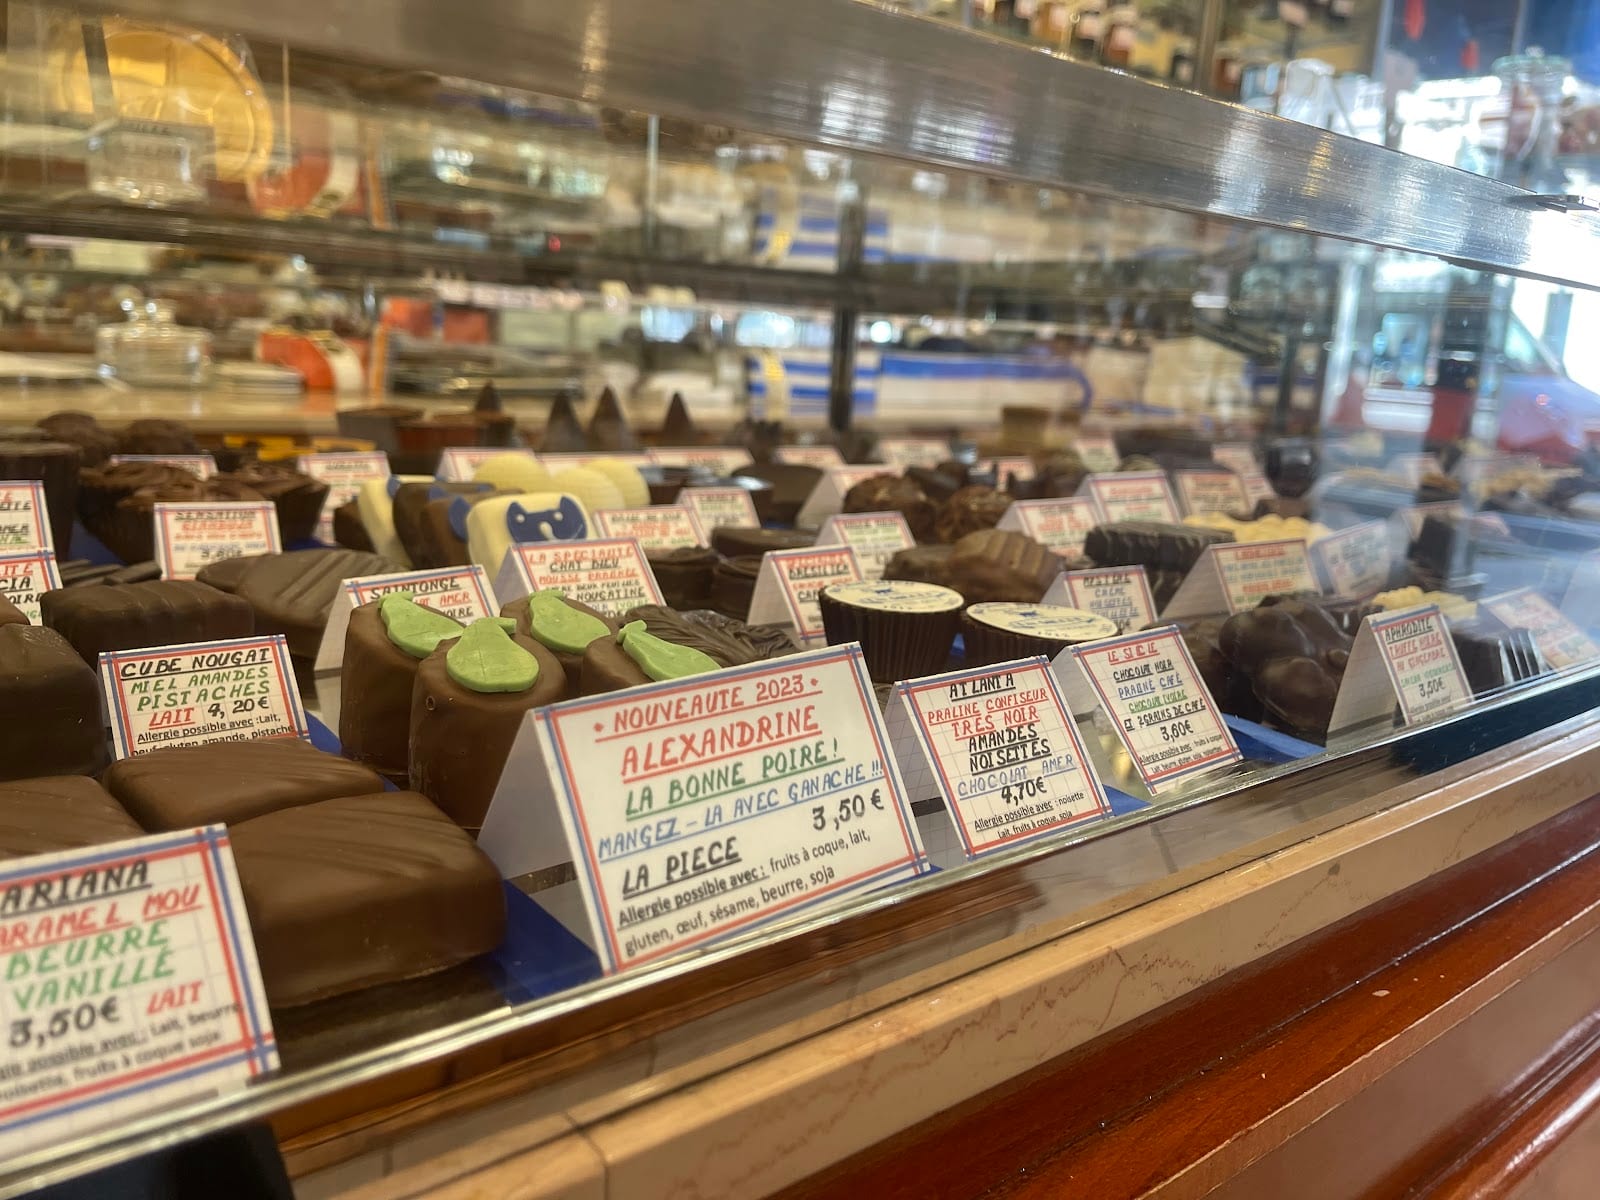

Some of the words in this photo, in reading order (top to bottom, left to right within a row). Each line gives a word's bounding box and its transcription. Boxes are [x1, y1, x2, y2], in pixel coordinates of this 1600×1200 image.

[530, 552, 546, 564] LA
[550, 560, 582, 571] CHAT
[539, 573, 581, 584] MOUSSE
[577, 586, 646, 600] NOUGATINE
[444, 607, 474, 617] OIRE
[1386, 617, 1433, 641] APHRODITE
[121, 658, 182, 677] CUBE
[192, 648, 270, 669] NOUGAT
[1108, 651, 1119, 663] LE
[1113, 663, 1151, 680] CHOCOLAT
[1154, 659, 1174, 672] NOIR
[131, 678, 177, 694] MIEL
[188, 666, 269, 687] AMANDES
[950, 673, 1014, 698] ATLANTA
[1419, 677, 1445, 698] 3,50€
[137, 681, 270, 711] PISTACHES
[614, 686, 744, 733] NOUVEAUTE
[756, 674, 804, 702] 2023
[928, 702, 980, 724] PRALINE
[986, 688, 1048, 711] CONFISEUR
[1128, 695, 1162, 713] CHOCOLAT
[138, 729, 180, 742] Allergie
[183, 722, 226, 737] possible
[229, 717, 254, 729] avec
[149, 707, 195, 726] LAIT
[952, 715, 996, 738] TRES
[1004, 705, 1039, 726] NOIR
[1124, 719, 1133, 730] ET
[1172, 705, 1184, 717] DE
[1160, 720, 1193, 743] 3,60€
[621, 705, 819, 776] ALEXANDRINE
[969, 723, 1038, 753] AMANDES
[970, 739, 1051, 772] NOISETTES
[626, 785, 653, 816] LA
[668, 761, 746, 804] BONNE
[957, 766, 1028, 797] CHOCOLAT
[1042, 754, 1074, 775] AMER
[1001, 776, 1047, 806] 4,70€
[598, 816, 681, 859] MANGEZ
[705, 804, 722, 826] LA
[734, 788, 780, 818] AVEC
[974, 815, 1004, 831] Allergie
[1005, 805, 1035, 824] possible
[1035, 800, 1053, 812] avec
[1012, 822, 1031, 837] fruits
[619, 896, 671, 926] Allergie
[674, 878, 727, 910] possible
[770, 853, 801, 872] fruits
[802, 847, 810, 862] à
[812, 838, 849, 858] coque,
[849, 829, 871, 846] lait,
[622, 863, 649, 895] LA
[666, 836, 740, 881] PIECE
[0, 859, 148, 913] ARIANA
[142, 884, 200, 917] MOU
[625, 927, 674, 957] gluten,
[709, 895, 760, 923] sésame,
[760, 878, 808, 903] beurre,
[810, 865, 835, 885] soja
[6, 919, 168, 981] BEURRE
[13, 948, 175, 1012] VANILLE
[147, 980, 203, 1015] LAIT
